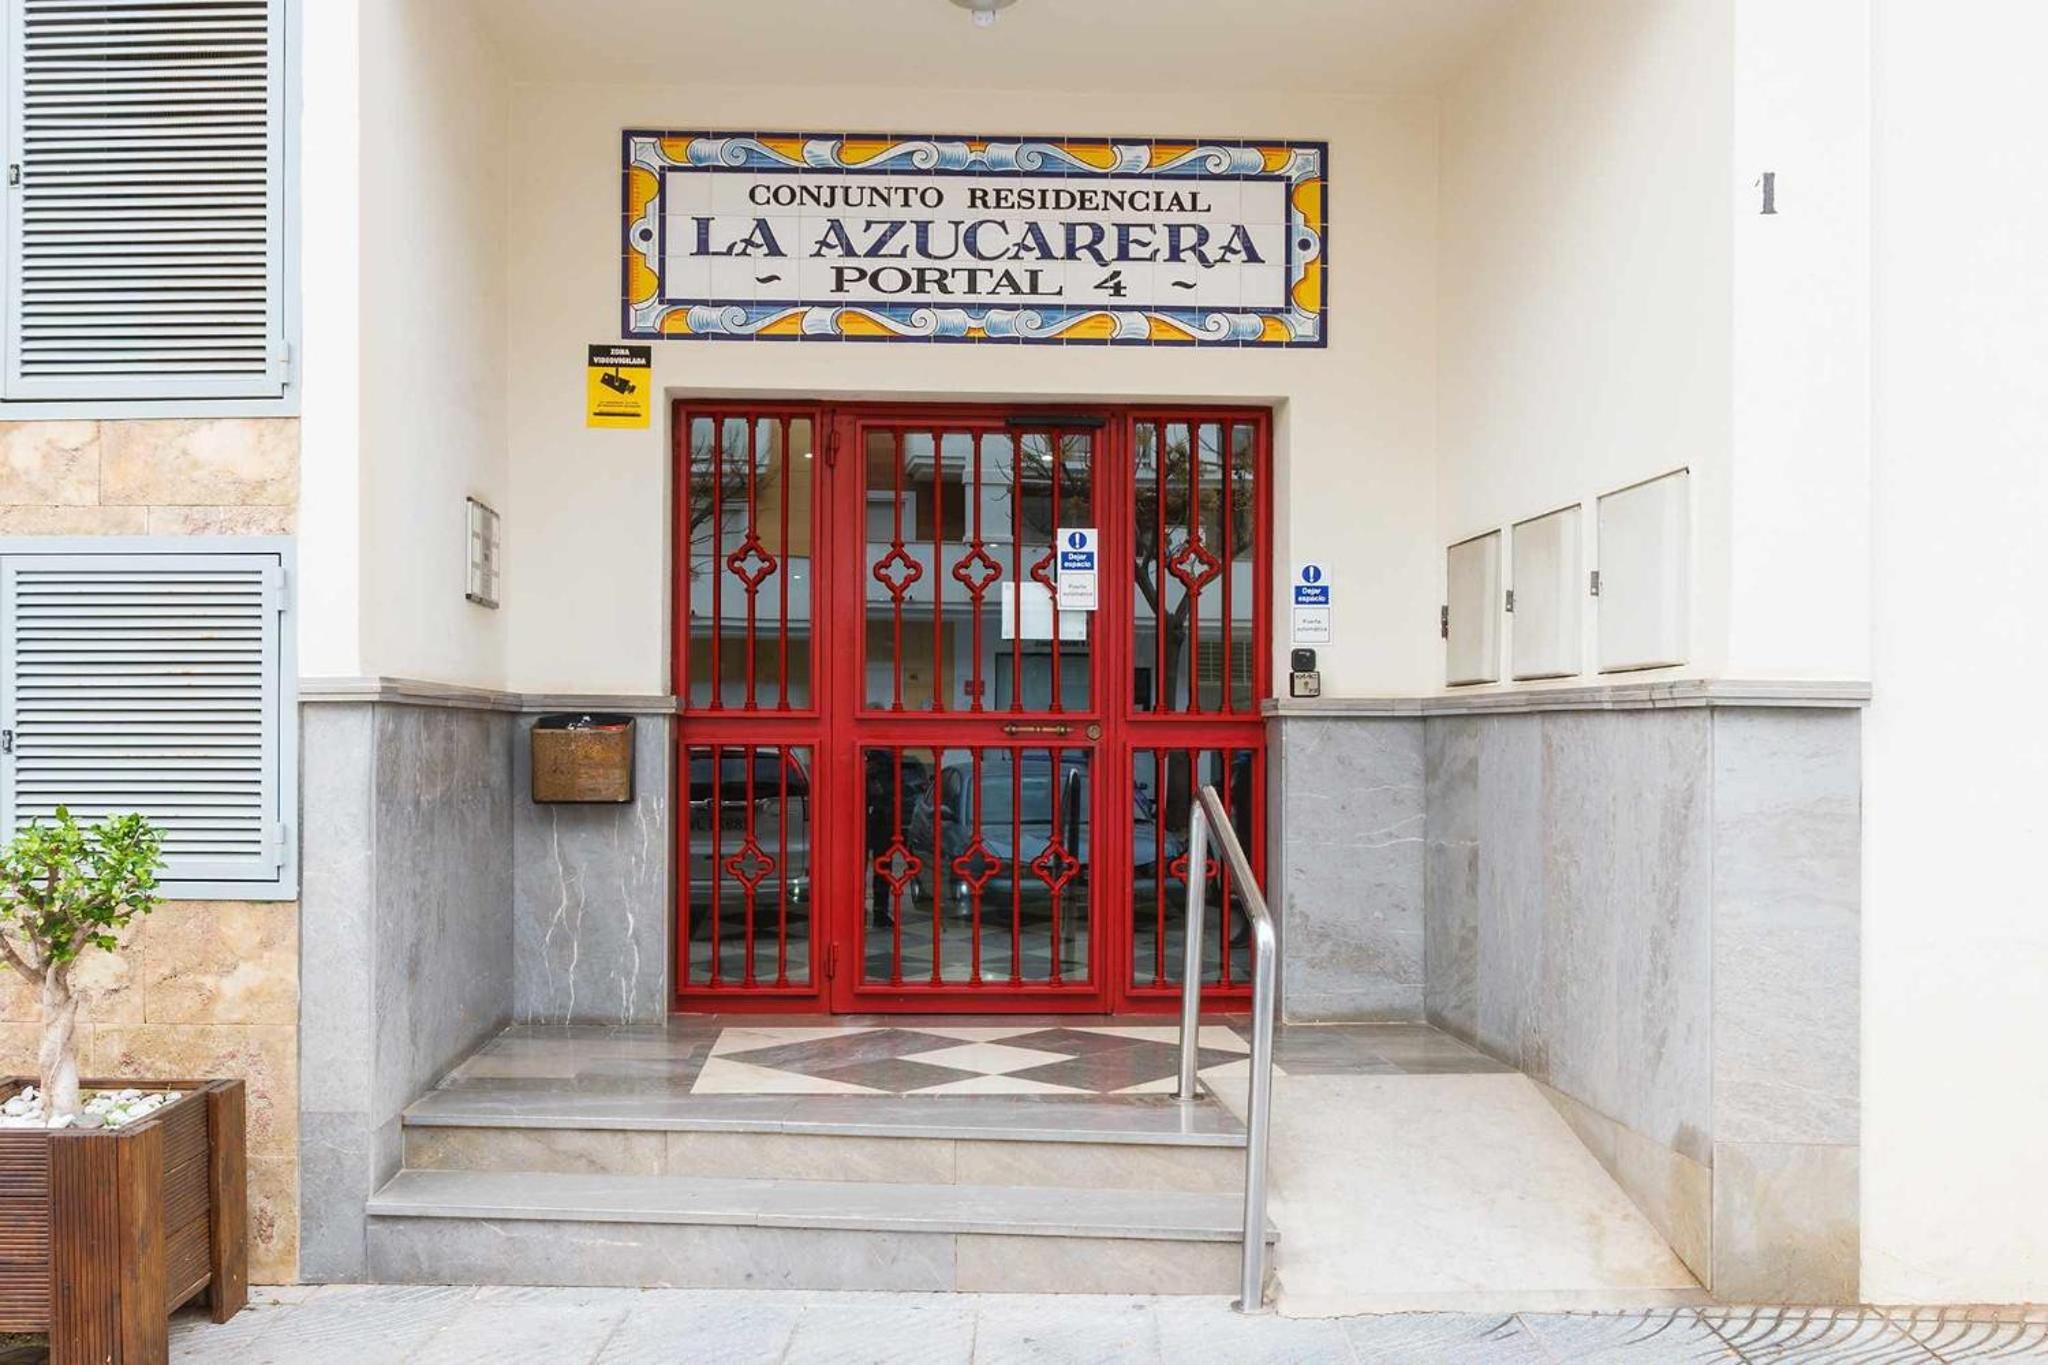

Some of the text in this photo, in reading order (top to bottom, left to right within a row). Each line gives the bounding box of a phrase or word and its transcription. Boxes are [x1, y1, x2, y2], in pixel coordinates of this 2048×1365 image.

[748, 184, 1212, 213] CONJUNTO RESIDENCIAL
[689, 216, 1267, 269] LA AZUCARERA
[829, 265, 1128, 298] PORTAL 4
[1068, 553, 1087, 562] Dejar
[1063, 561, 1092, 569] espacio
[1301, 587, 1322, 597] Dejar
[1297, 595, 1327, 604] espacio
